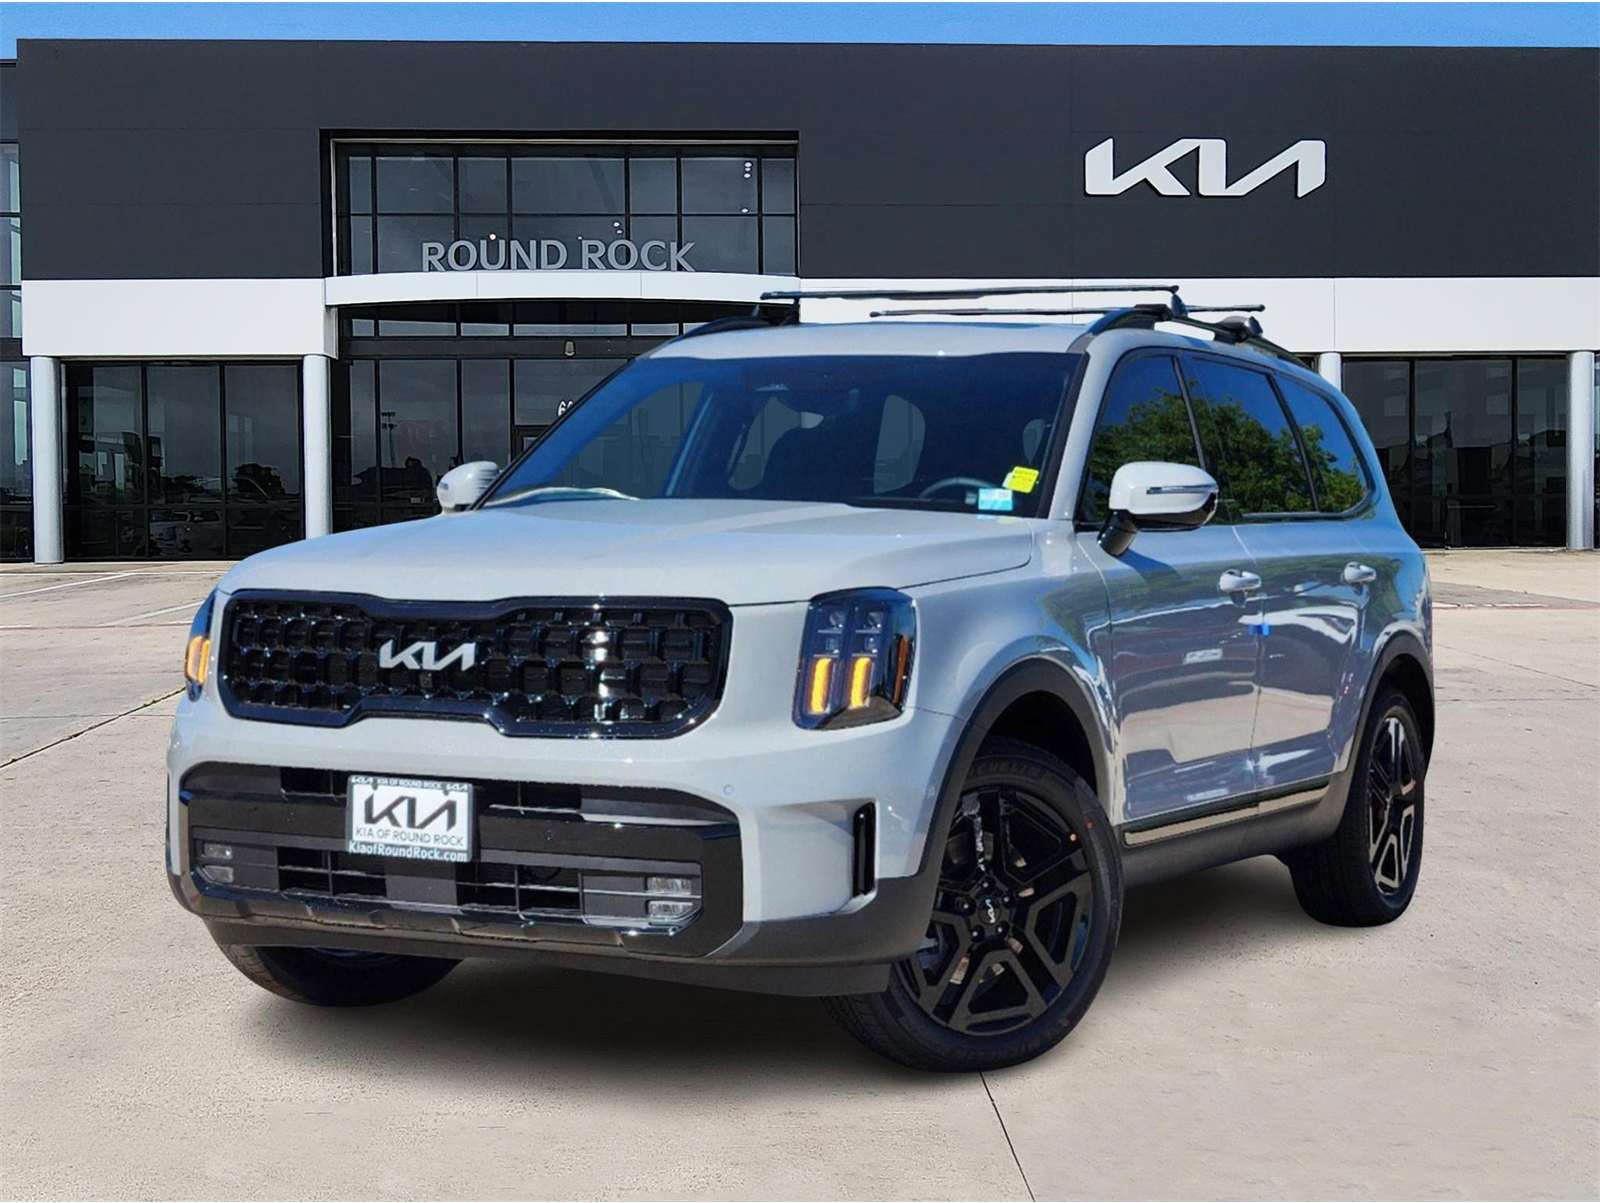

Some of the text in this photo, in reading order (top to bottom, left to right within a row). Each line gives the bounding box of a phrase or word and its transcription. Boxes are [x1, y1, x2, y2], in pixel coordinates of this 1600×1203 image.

[1085, 137, 1326, 198] KIA
[421, 239, 696, 272] ROUND ROCK
[557, 400, 574, 417] 6
[379, 639, 476, 671] KIA
[364, 792, 457, 832] KIA
[348, 840, 469, 863] KiaofRoundRock.com
[356, 827, 465, 847] KIA OF ROUND ROCK
